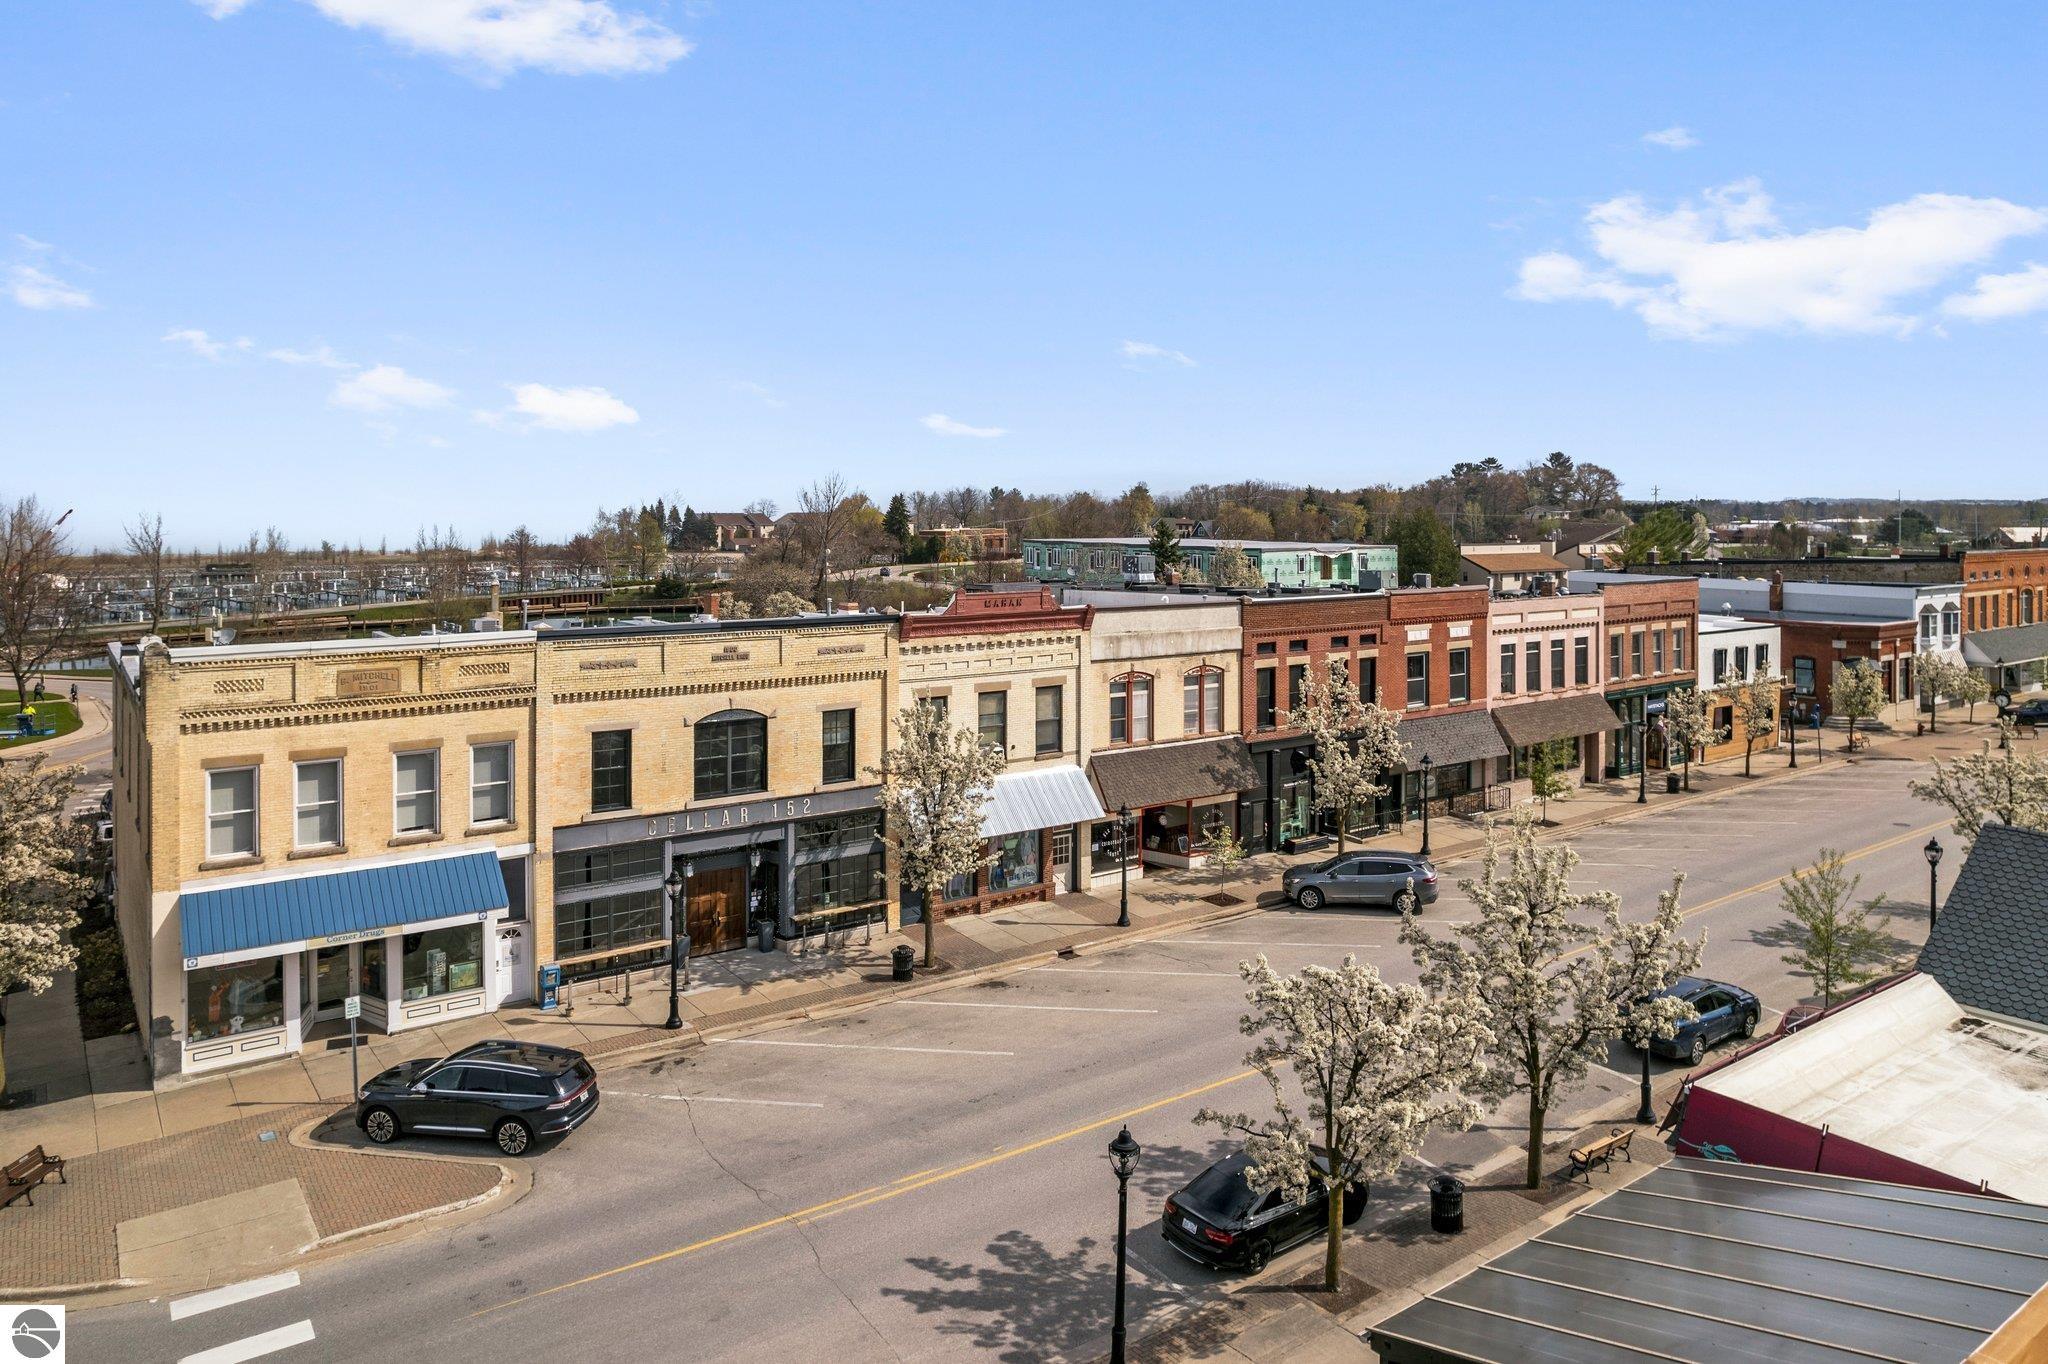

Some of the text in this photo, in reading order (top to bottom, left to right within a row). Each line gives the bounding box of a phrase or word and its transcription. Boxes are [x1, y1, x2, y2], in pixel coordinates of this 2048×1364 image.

[352, 671, 397, 682] MITCHELL
[648, 798, 812, 836] CELLAR 152
[326, 929, 385, 944] Corner Drugs
